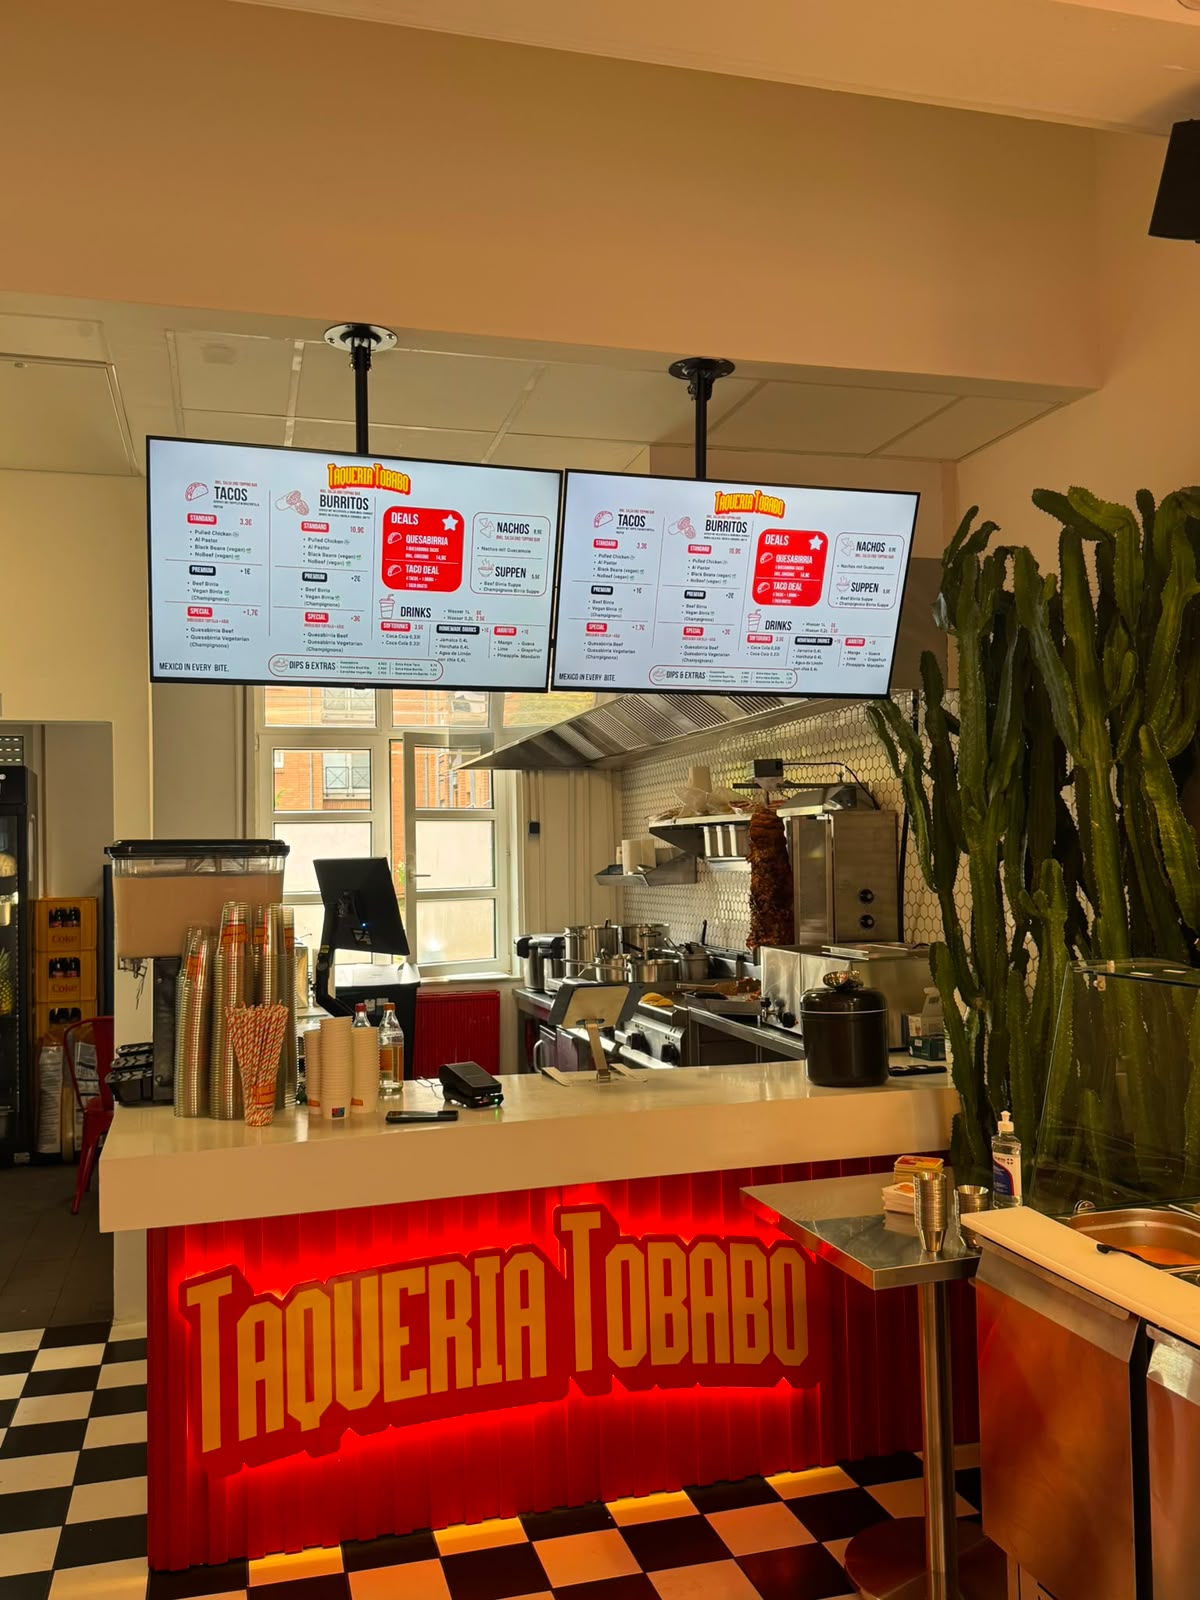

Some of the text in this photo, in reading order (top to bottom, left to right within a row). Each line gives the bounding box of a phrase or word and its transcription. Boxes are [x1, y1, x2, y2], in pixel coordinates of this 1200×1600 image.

[328, 463, 409, 492] TAQUERIA TOBABO
[214, 486, 248, 501] TACOS
[320, 495, 369, 510] BURRITOS
[715, 491, 784, 516] TAQUERIA TOBABO
[391, 512, 419, 525] DEALS
[618, 514, 646, 527] TACOS
[497, 522, 530, 534] NACHOS
[705, 520, 747, 533] BURRITOS
[406, 534, 448, 546] QUESABIRRIA
[765, 534, 790, 546] DEALS
[856, 541, 886, 552] NACHOS
[776, 555, 813, 564] QUESABIRRIA
[191, 566, 214, 574] PREMIUM
[405, 564, 439, 575] TACO DEAL
[495, 566, 526, 578] SUPPEN
[773, 581, 802, 591] TACO DEAL
[851, 582, 879, 593] SUPPEN
[400, 606, 431, 618] DRINKS
[765, 620, 792, 631] DRINKS
[159, 662, 229, 672] MEXICO IN EVERY BITE.
[289, 661, 303, 669] DIPS
[305, 661, 309, 669] &
[311, 662, 335, 670] EXTRAS
[586, 673, 602, 681] EVERY
[666, 670, 679, 679] DIPS
[680, 671, 684, 679] &
[685, 671, 706, 680] EXTRAS
[52, 935, 78, 943] Coke
[52, 984, 78, 993] Coke
[187, 1211, 809, 1454] TAQUERIA TOBABO
